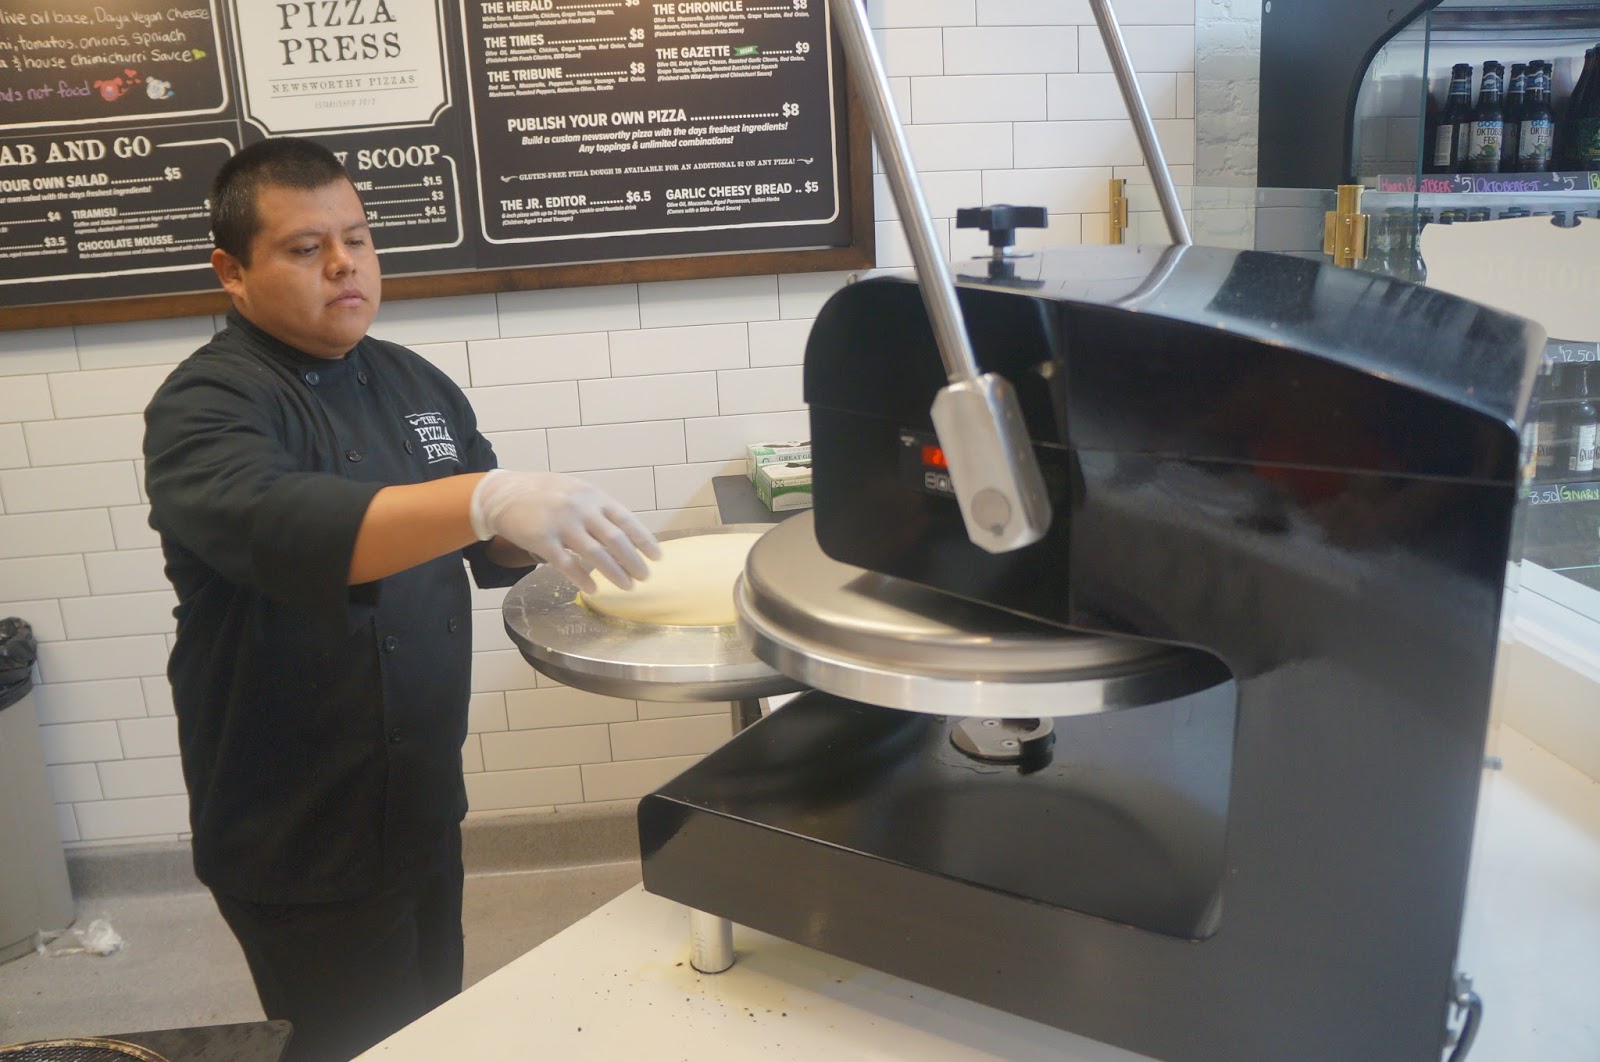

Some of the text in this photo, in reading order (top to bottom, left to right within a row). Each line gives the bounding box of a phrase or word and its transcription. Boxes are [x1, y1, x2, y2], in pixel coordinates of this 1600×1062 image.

[277, 0, 397, 30] PIZZA
[480, 2, 504, 14] THE
[506, 0, 553, 13] HERALD
[652, 0, 808, 15] THE CHRONICLE $8
[131, 11, 162, 27] Vegan
[167, 8, 209, 21] Cheese
[483, 27, 645, 49] THE TIMES $8
[278, 31, 401, 66] PRESS
[655, 47, 679, 60] THE
[680, 45, 731, 59] GAZETTE
[795, 41, 810, 55] $9
[22, 54, 67, 69] house
[151, 49, 192, 62] Sauce
[486, 61, 646, 83] THE TRIBUNE $8
[27, 83, 54, 100] not
[57, 80, 91, 98] food
[272, 74, 415, 94] NEWSWORTHY PIZZAS
[507, 101, 800, 132] PUBLISH YOUR OWN PIZZA $8
[521, 121, 789, 146] Build a custom newsworthy pizza with the days freshest ingredients!
[45, 139, 106, 164] AND
[113, 135, 152, 159] GO
[578, 135, 735, 155] Any toppings & unlimited combinations!
[357, 144, 440, 170] SCOOP
[33, 176, 65, 191] OWN
[66, 173, 109, 188] SALAD
[164, 166, 182, 182] $5
[518, 172, 568, 182] GLUTEN-FREE
[568, 170, 589, 178] PIZZA
[590, 168, 614, 177] DOUGH
[623, 165, 664, 175] AVAILABLE
[664, 164, 679, 172] FOR
[680, 163, 692, 171] AN
[693, 161, 737, 170] ADDITIONAL
[757, 159, 773, 167] ANY
[773, 158, 796, 166] PIZZA!
[354, 175, 443, 192] KIE $1.5
[665, 180, 819, 201] GARLIC CHEESY BREAD $5
[57, 192, 69, 200] the
[69, 191, 85, 200] days
[86, 188, 112, 198] freshest
[431, 190, 444, 201] $3
[500, 190, 652, 211] THE JR. EDITOR $6.5
[47, 211, 62, 223] $4
[71, 207, 118, 219] TIRAMISU
[424, 205, 446, 217] $4.5
[43, 236, 67, 248] $3.5
[77, 238, 133, 251] CHOCOLATE
[134, 234, 174, 247] MOUSSE
[420, 415, 438, 425] THE
[414, 426, 453, 442] PIZZA
[422, 442, 458, 460] PRESS
